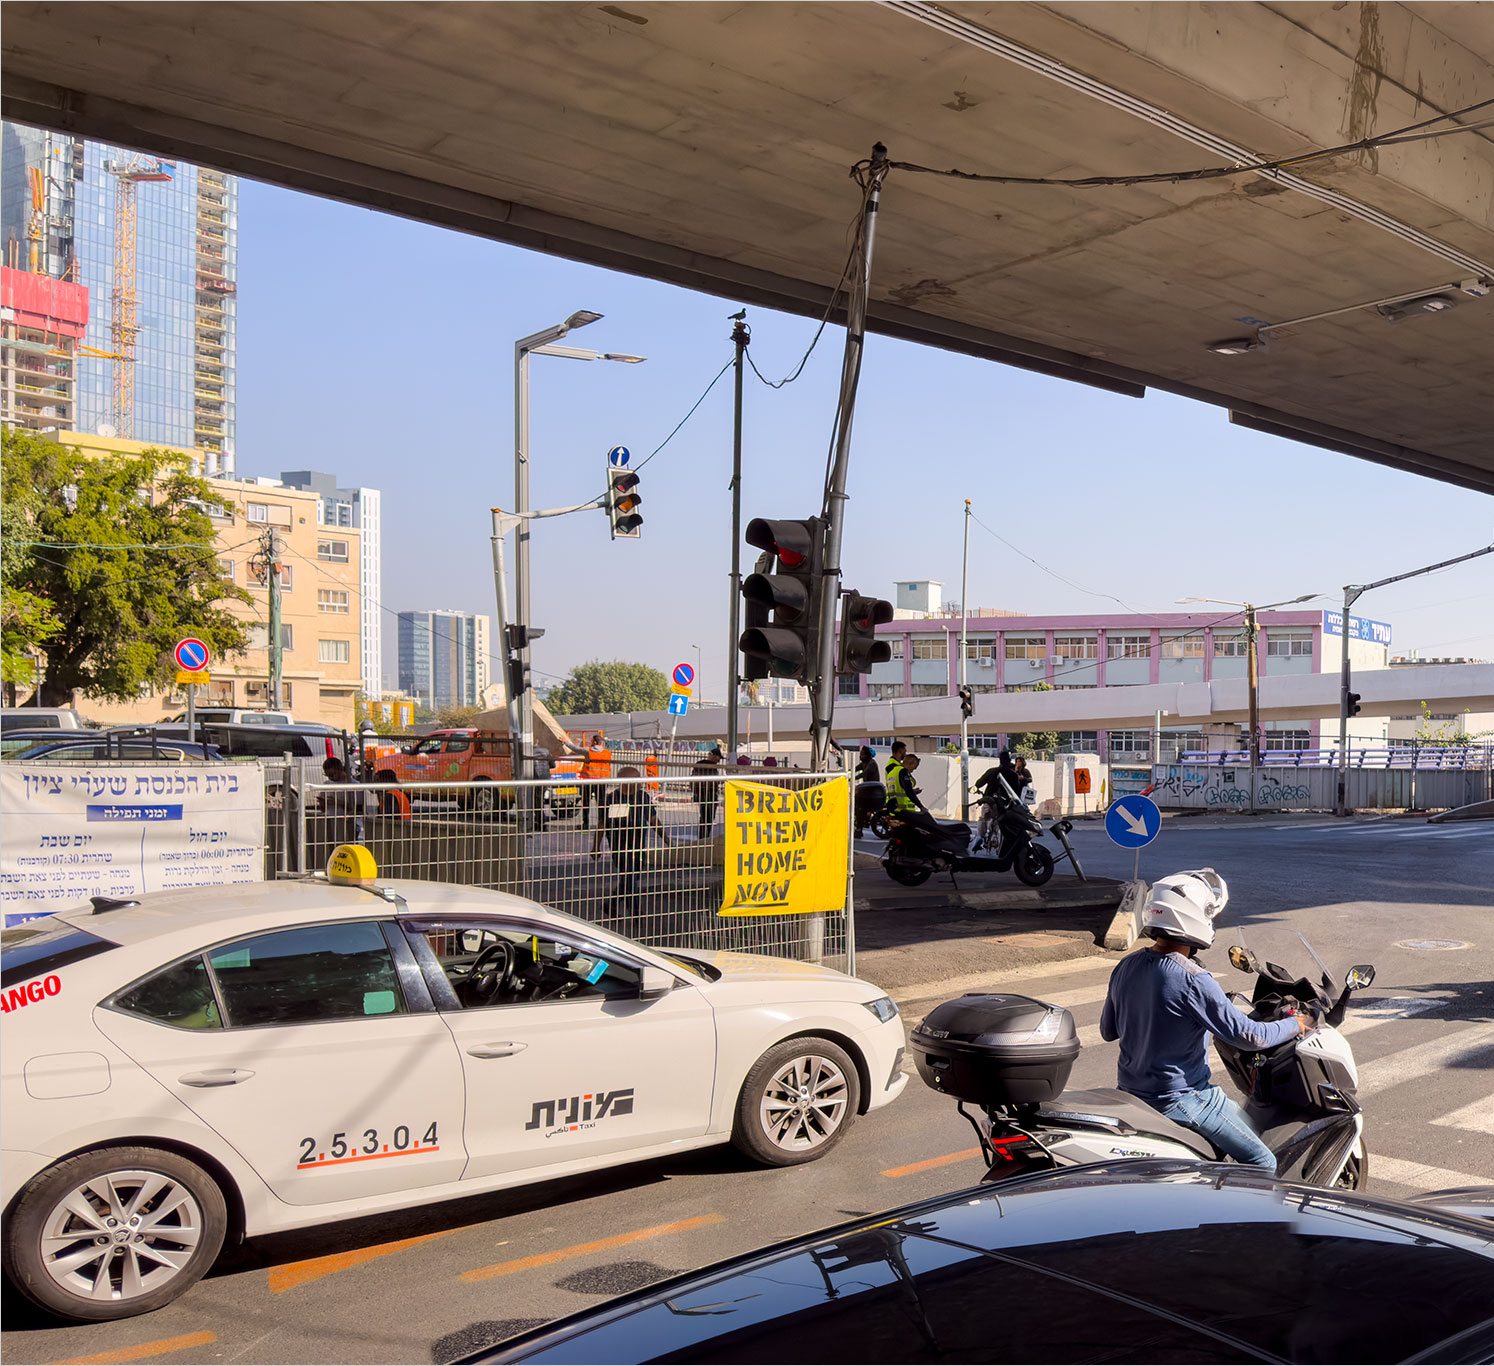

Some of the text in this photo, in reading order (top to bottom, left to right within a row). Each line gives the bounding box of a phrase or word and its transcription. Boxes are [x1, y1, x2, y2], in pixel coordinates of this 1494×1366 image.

[1371, 623, 1391, 642] עתיד
[21, 773, 239, 800] בית הכנסת שערי ציון
[736, 789, 823, 814] BRING
[104, 806, 168, 820] זמני תפילה
[189, 826, 228, 843] יום חול
[736, 819, 808, 845] THEM
[39, 834, 93, 848] יום שבת
[52, 853, 79, 864] 07:30
[81, 852, 113, 864] שחרית
[200, 848, 225, 859] 06:00
[225, 847, 254, 858] שחרית
[737, 848, 807, 876] HOME
[91, 886, 101, 896] 10
[733, 879, 790, 905] NOW
[525, 1087, 634, 1131] מונית
[579, 1122, 596, 1130] Taxi
[298, 1121, 439, 1164] 2.5.3.0.4
